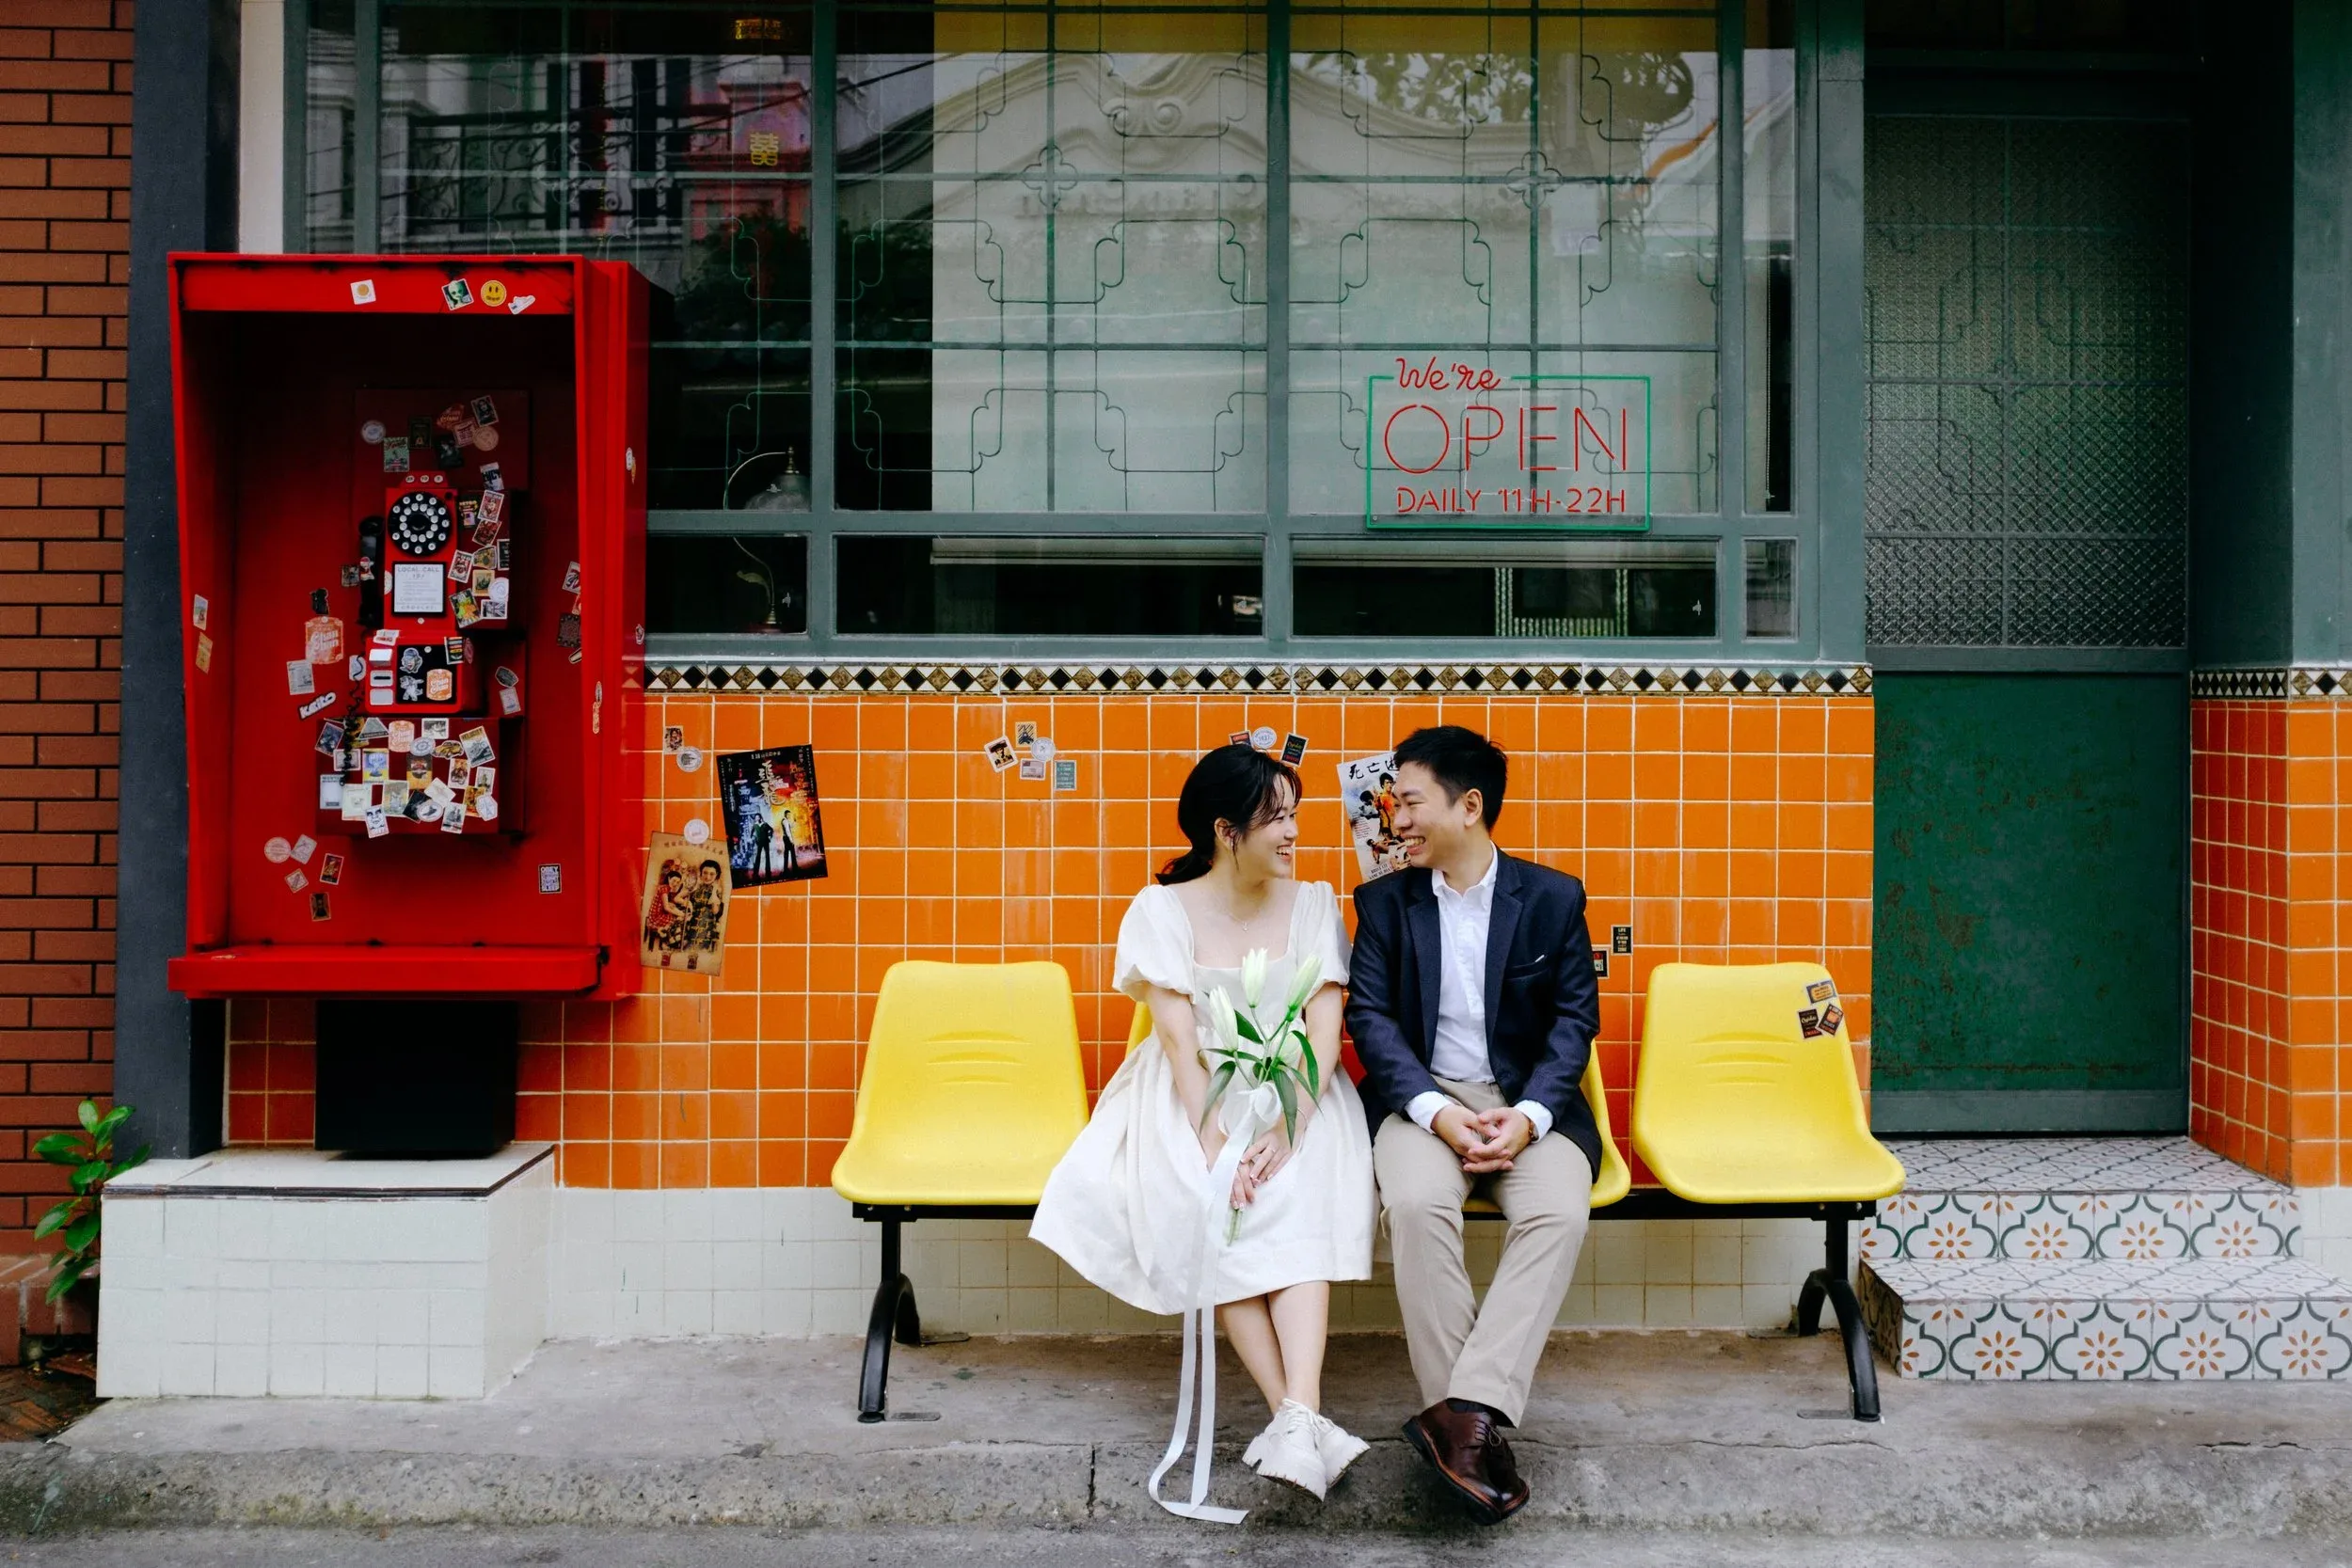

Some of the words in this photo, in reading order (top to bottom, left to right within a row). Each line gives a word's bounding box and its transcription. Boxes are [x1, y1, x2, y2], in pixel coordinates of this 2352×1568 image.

[1396, 356, 1501, 390] We're
[1384, 404, 1627, 474] OPEN
[1396, 487, 1482, 513] DAILY
